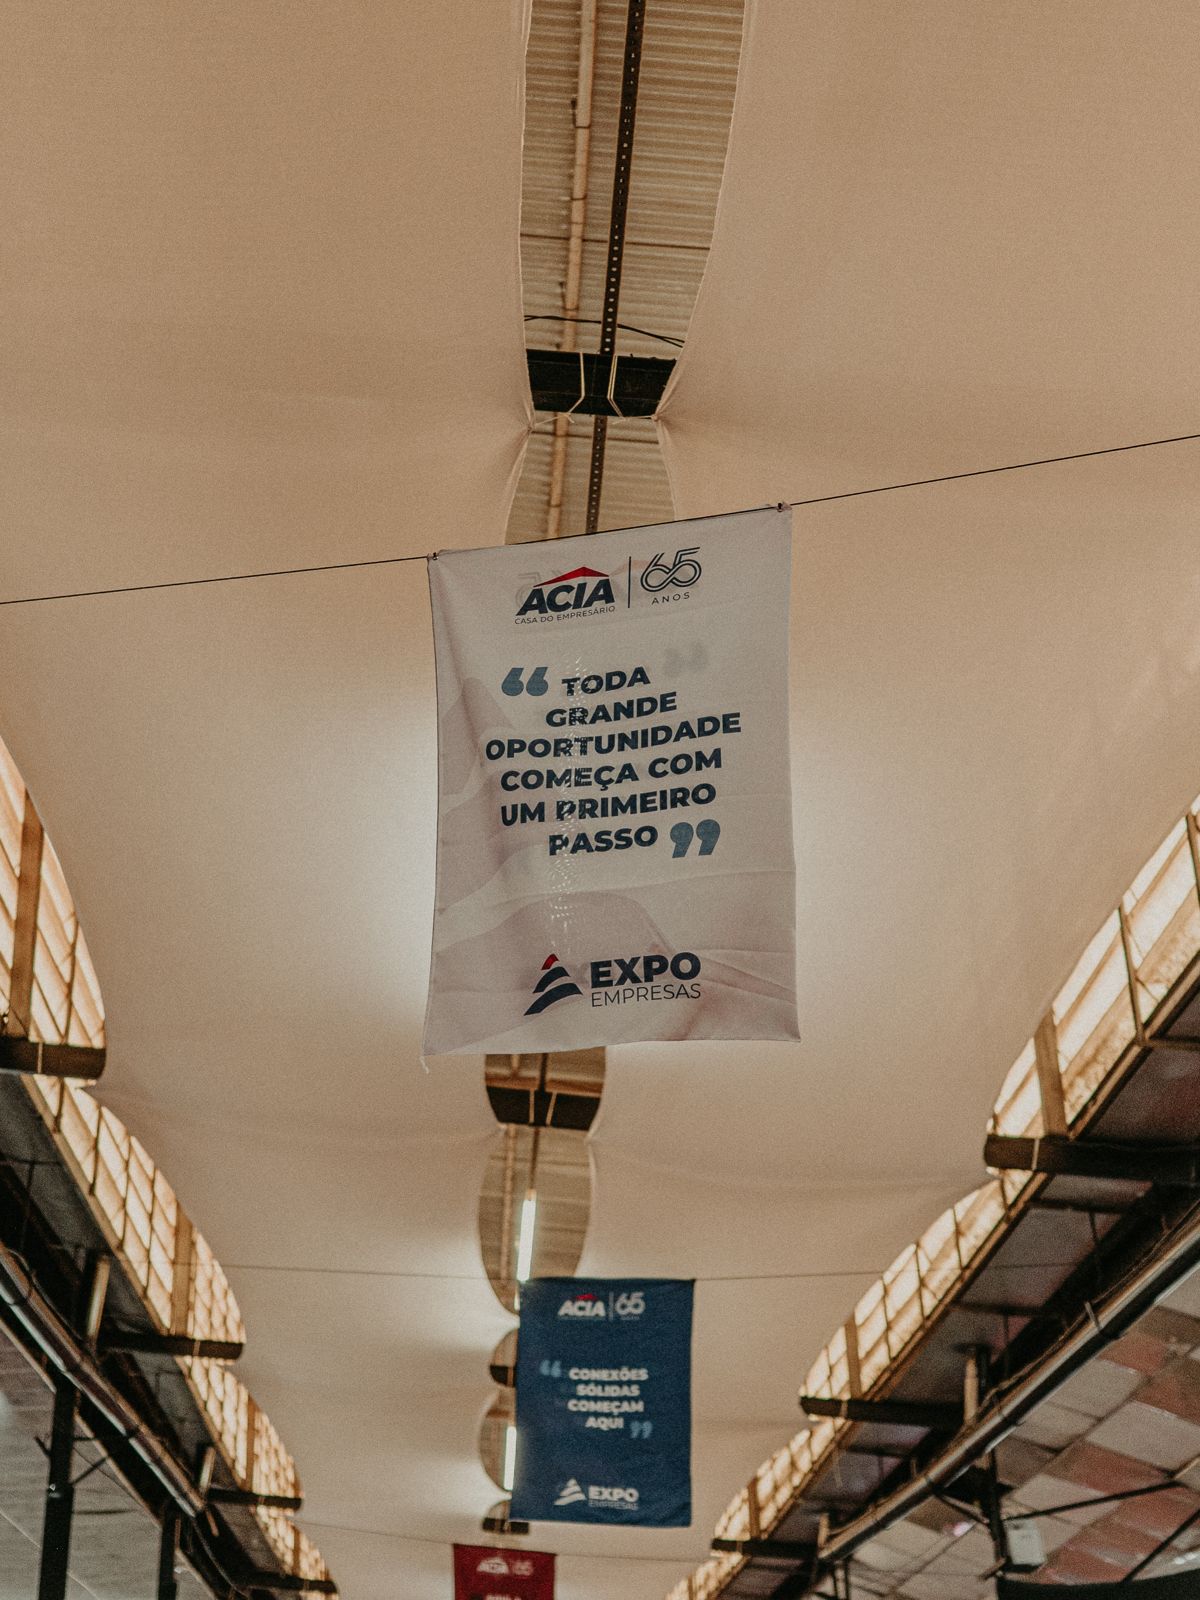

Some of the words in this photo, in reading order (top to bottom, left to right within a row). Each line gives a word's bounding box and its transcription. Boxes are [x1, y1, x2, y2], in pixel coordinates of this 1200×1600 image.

[640, 547, 702, 592] 65
[516, 579, 615, 616] ACIA
[651, 591, 690, 605] ANOS
[514, 617, 538, 625] CASA
[540, 615, 554, 623] DO
[556, 605, 616, 621] EMPRESÁRIO
[561, 666, 651, 697] TODA
[545, 691, 677, 728] GRANDE
[485, 712, 742, 761] OPORTUNIDADE
[500, 762, 640, 791] COMEÇA
[648, 747, 722, 778] COM
[501, 801, 546, 826] UM
[556, 783, 717, 821] PRIMEIRO
[549, 825, 659, 856] PASSO
[590, 952, 701, 989] EXPO
[591, 983, 701, 1008] EMPRESAS
[557, 1300, 606, 1317] ACIA
[568, 1366, 649, 1381] CONEXÕES
[576, 1383, 641, 1397] SÓLIDAS
[567, 1399, 645, 1416] COMEÇAM
[585, 1416, 625, 1431] AQUI
[588, 1485, 639, 1502] EXPO
